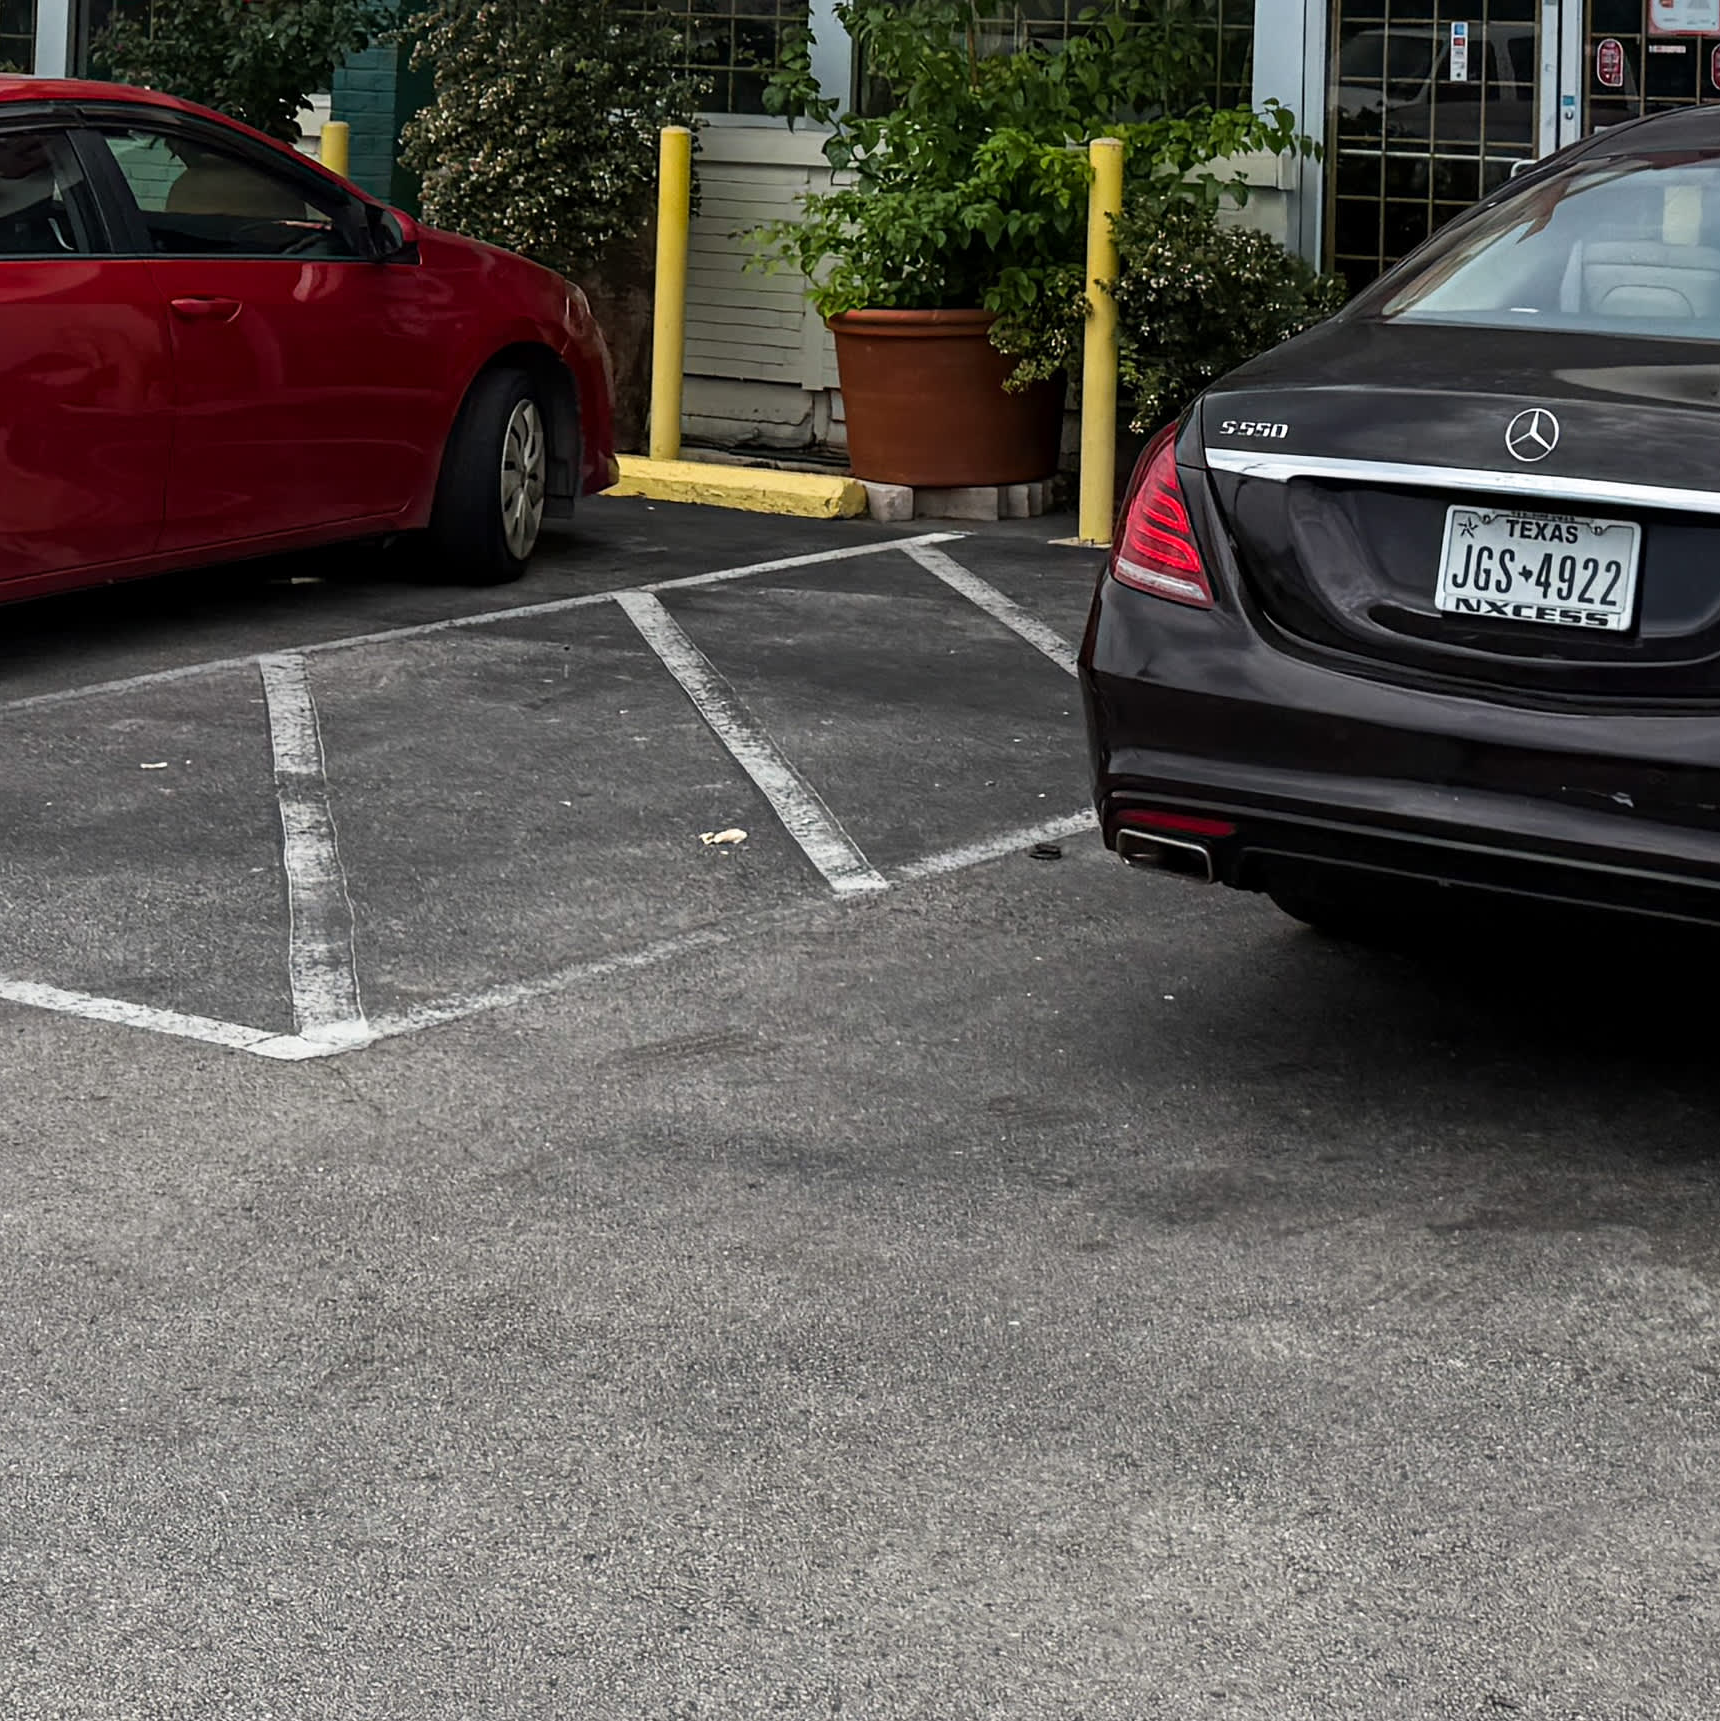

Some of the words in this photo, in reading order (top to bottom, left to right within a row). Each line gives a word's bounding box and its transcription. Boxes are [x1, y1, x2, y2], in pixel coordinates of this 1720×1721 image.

[1506, 519, 1579, 545] TEXAS
[1451, 543, 1516, 594] JGS
[1535, 552, 1622, 607] 4922
[1454, 597, 1609, 627] NXCESS
